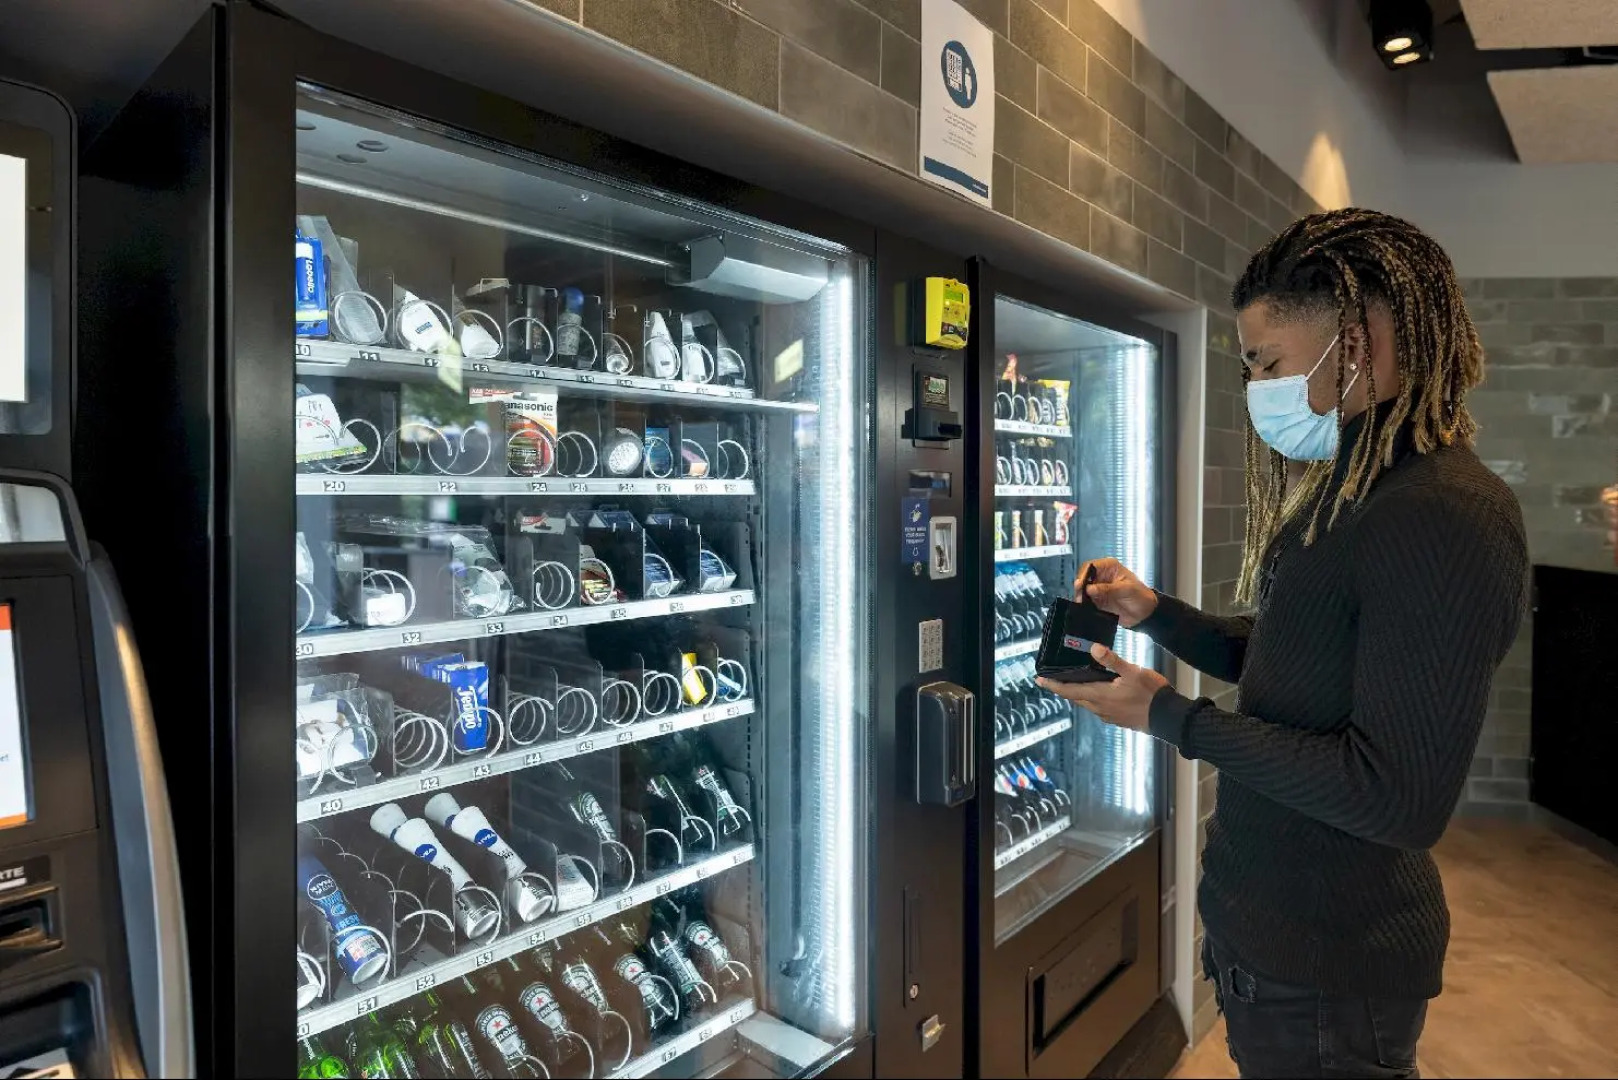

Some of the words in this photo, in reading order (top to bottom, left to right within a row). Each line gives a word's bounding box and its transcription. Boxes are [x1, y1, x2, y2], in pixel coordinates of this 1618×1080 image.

[305, 259, 315, 294] Labello
[361, 352, 378, 361] 11
[427, 358, 440, 367] 12
[326, 482, 344, 492] 20
[440, 482, 455, 492] 22
[532, 483, 547, 491] 24
[552, 616, 567, 625] 34
[488, 623, 503, 633] 33
[402, 633, 420, 643] 32
[296, 644, 312, 655] 30
[457, 686, 482, 734] Tempo
[579, 741, 593, 752] 45
[526, 753, 541, 764] 44
[475, 765, 490, 777] 43
[421, 777, 439, 789] 42
[322, 800, 342, 812] 40
[530, 931, 546, 944] 54
[477, 952, 493, 966] 53
[417, 974, 435, 989] 52
[358, 997, 377, 1013] 51
